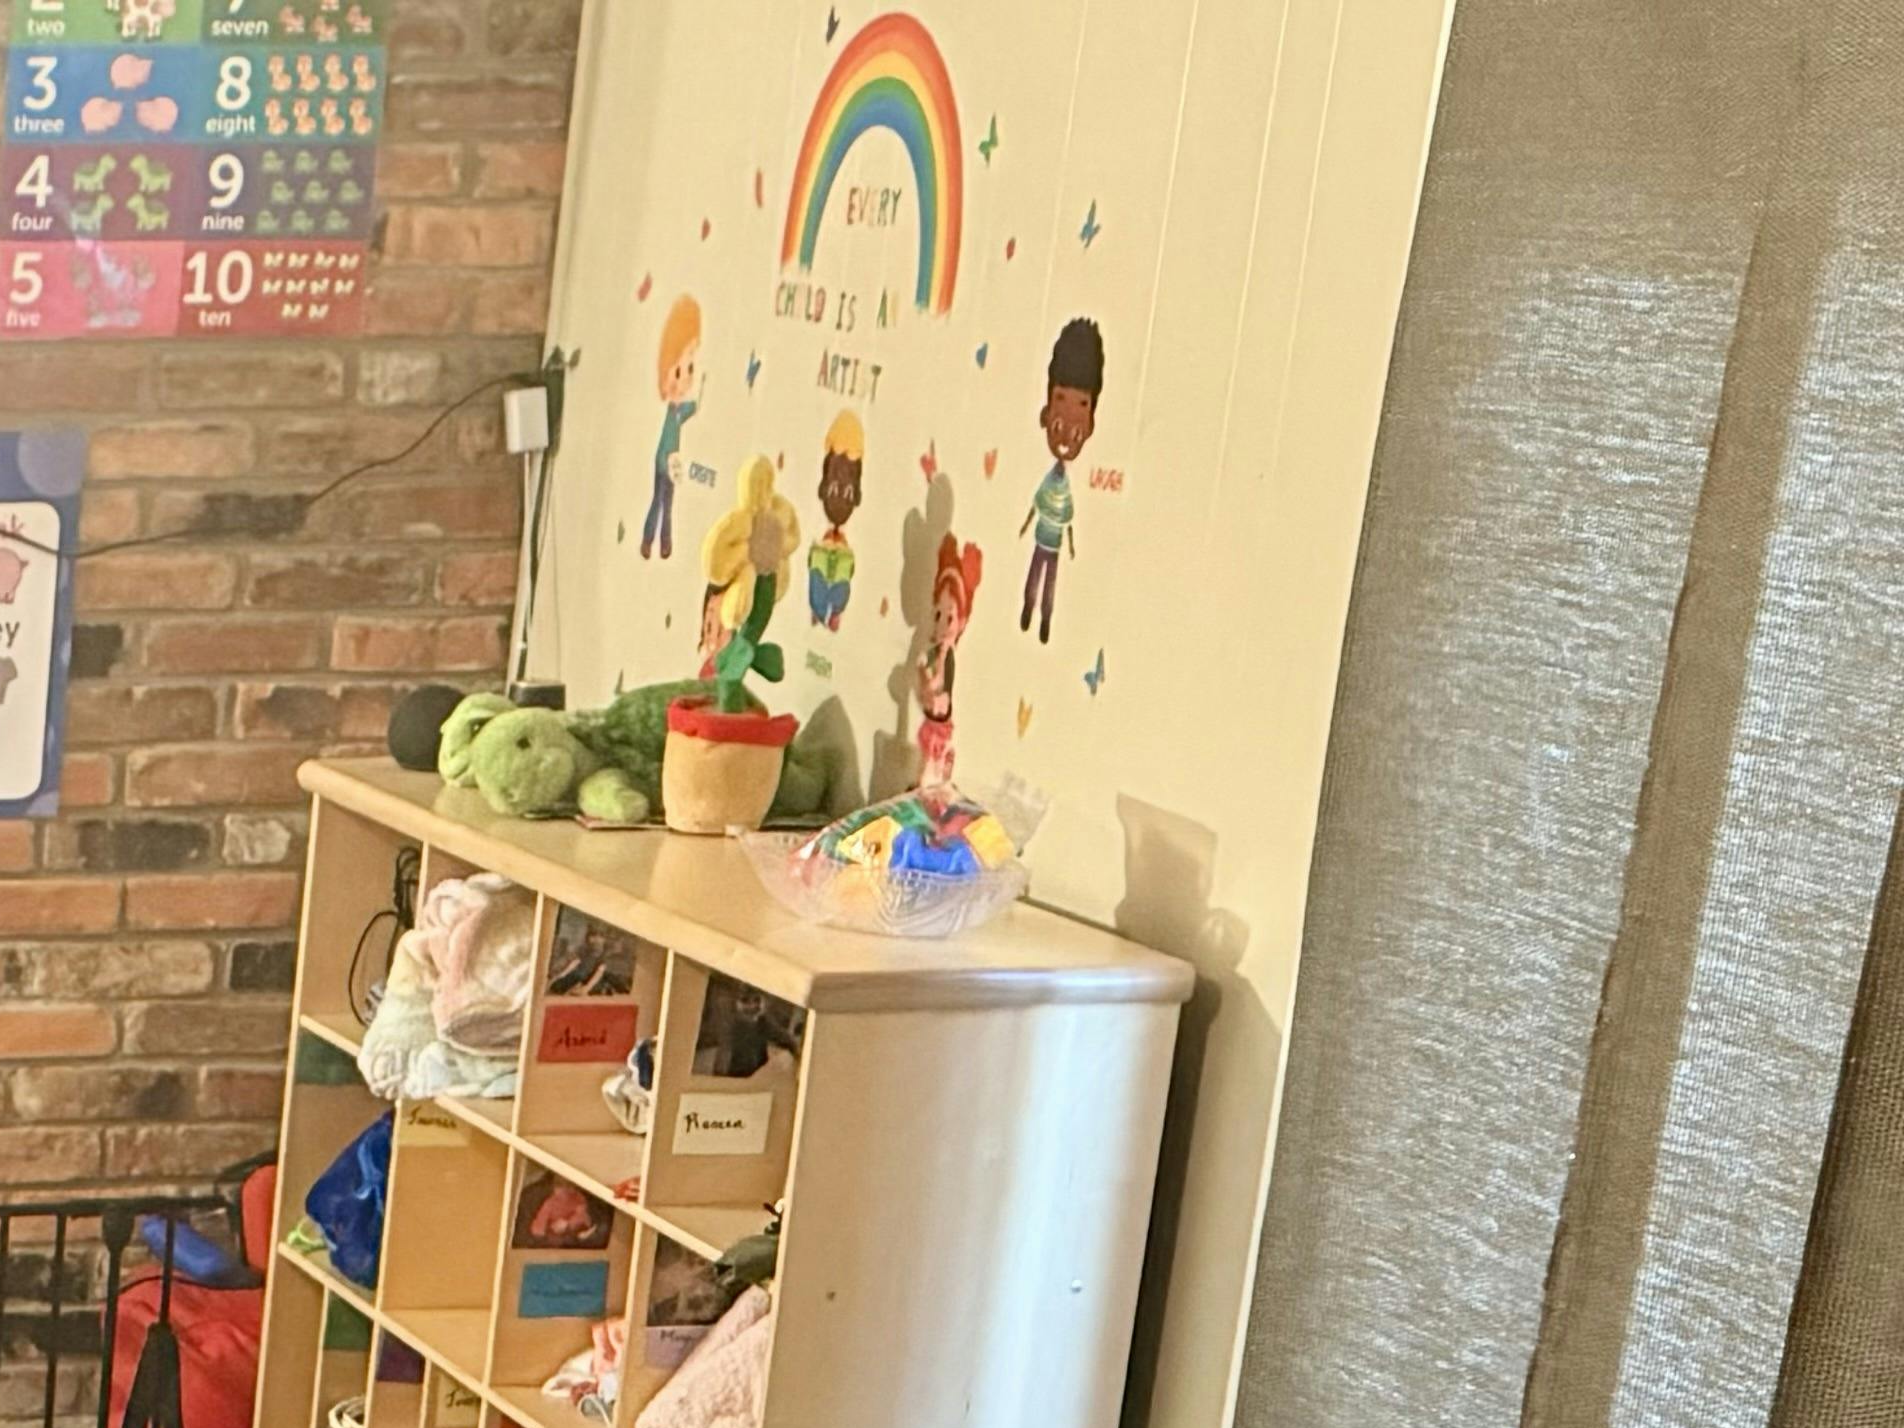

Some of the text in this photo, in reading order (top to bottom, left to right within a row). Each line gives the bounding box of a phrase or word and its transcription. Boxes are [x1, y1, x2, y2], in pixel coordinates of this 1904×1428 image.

[28, 19, 65, 36] two
[212, 19, 269, 36] seven
[23, 55, 58, 110] 3
[215, 55, 252, 110] 8
[14, 116, 64, 134] three
[206, 116, 256, 138] eight
[15, 154, 54, 208] 4
[208, 153, 245, 208] 9
[11, 211, 54, 231] four
[201, 211, 245, 230] nine
[9, 251, 43, 305] 5
[182, 250, 253, 305] 10
[6, 309, 42, 328] five
[198, 309, 232, 327] ten
